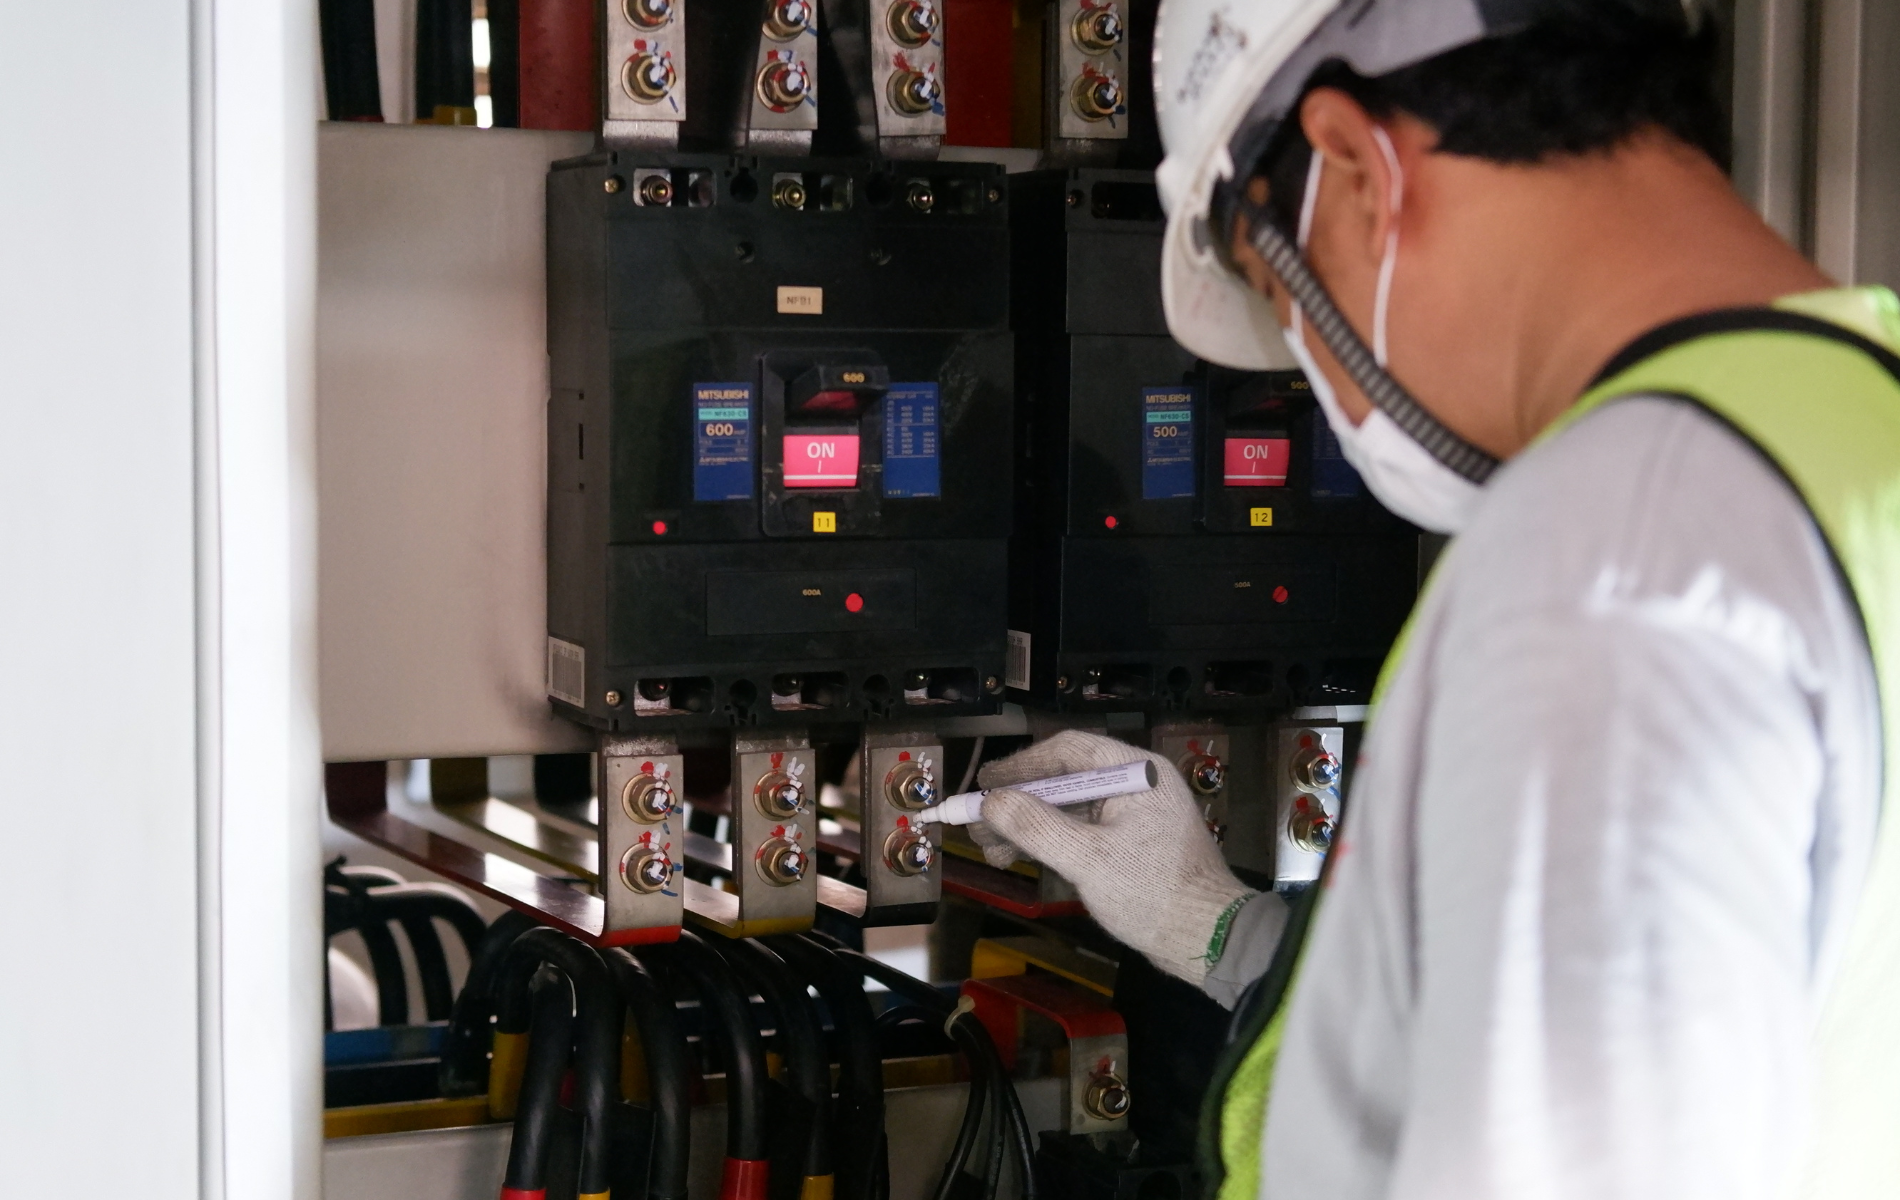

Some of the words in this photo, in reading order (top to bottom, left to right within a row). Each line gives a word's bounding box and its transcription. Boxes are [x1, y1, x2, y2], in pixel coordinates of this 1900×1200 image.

[842, 372, 865, 383] 600
[698, 389, 749, 400] MITSUBISHI
[1145, 394, 1191, 404] MITSUBISHI
[706, 423, 734, 436] 600
[1153, 426, 1177, 438] 500
[807, 442, 835, 459] ON
[1243, 444, 1268, 459] ON
[817, 518, 830, 528] 11
[1254, 512, 1268, 523] 12
[802, 588, 821, 596] 600A
